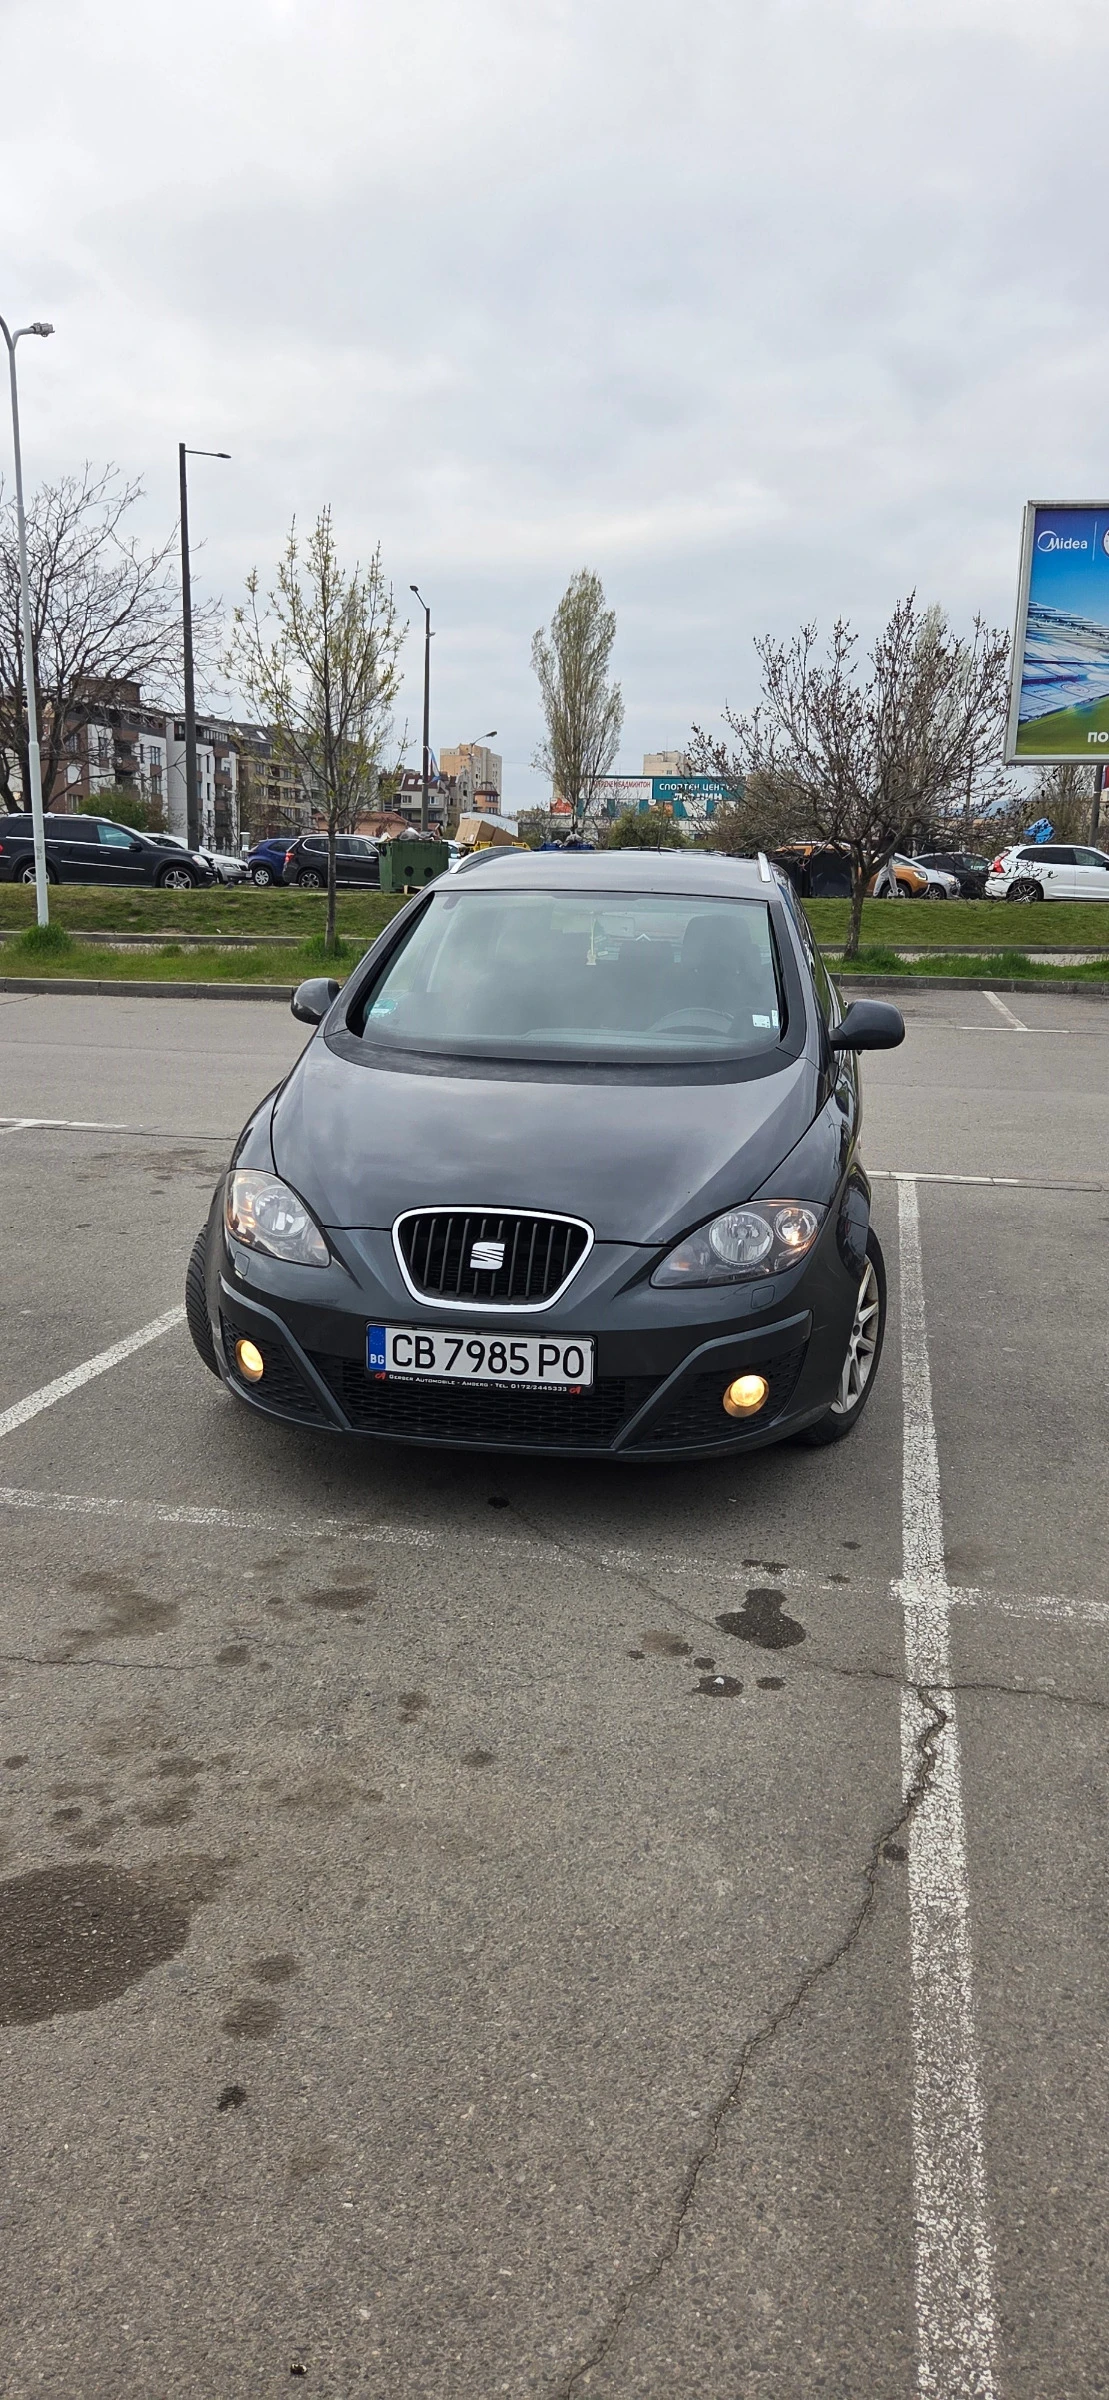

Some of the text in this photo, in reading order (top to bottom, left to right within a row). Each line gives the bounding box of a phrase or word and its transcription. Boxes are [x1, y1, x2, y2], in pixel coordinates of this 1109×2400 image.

[1045, 537, 1088, 550] Midea
[659, 783, 700, 791] СПОРТЕН
[370, 1353, 385, 1365] BG
[392, 1333, 436, 1369] CB
[444, 1338, 530, 1376] 7985
[415, 1377, 456, 1385] AUTOMOBILE
[461, 1380, 489, 1388] AMBERG
